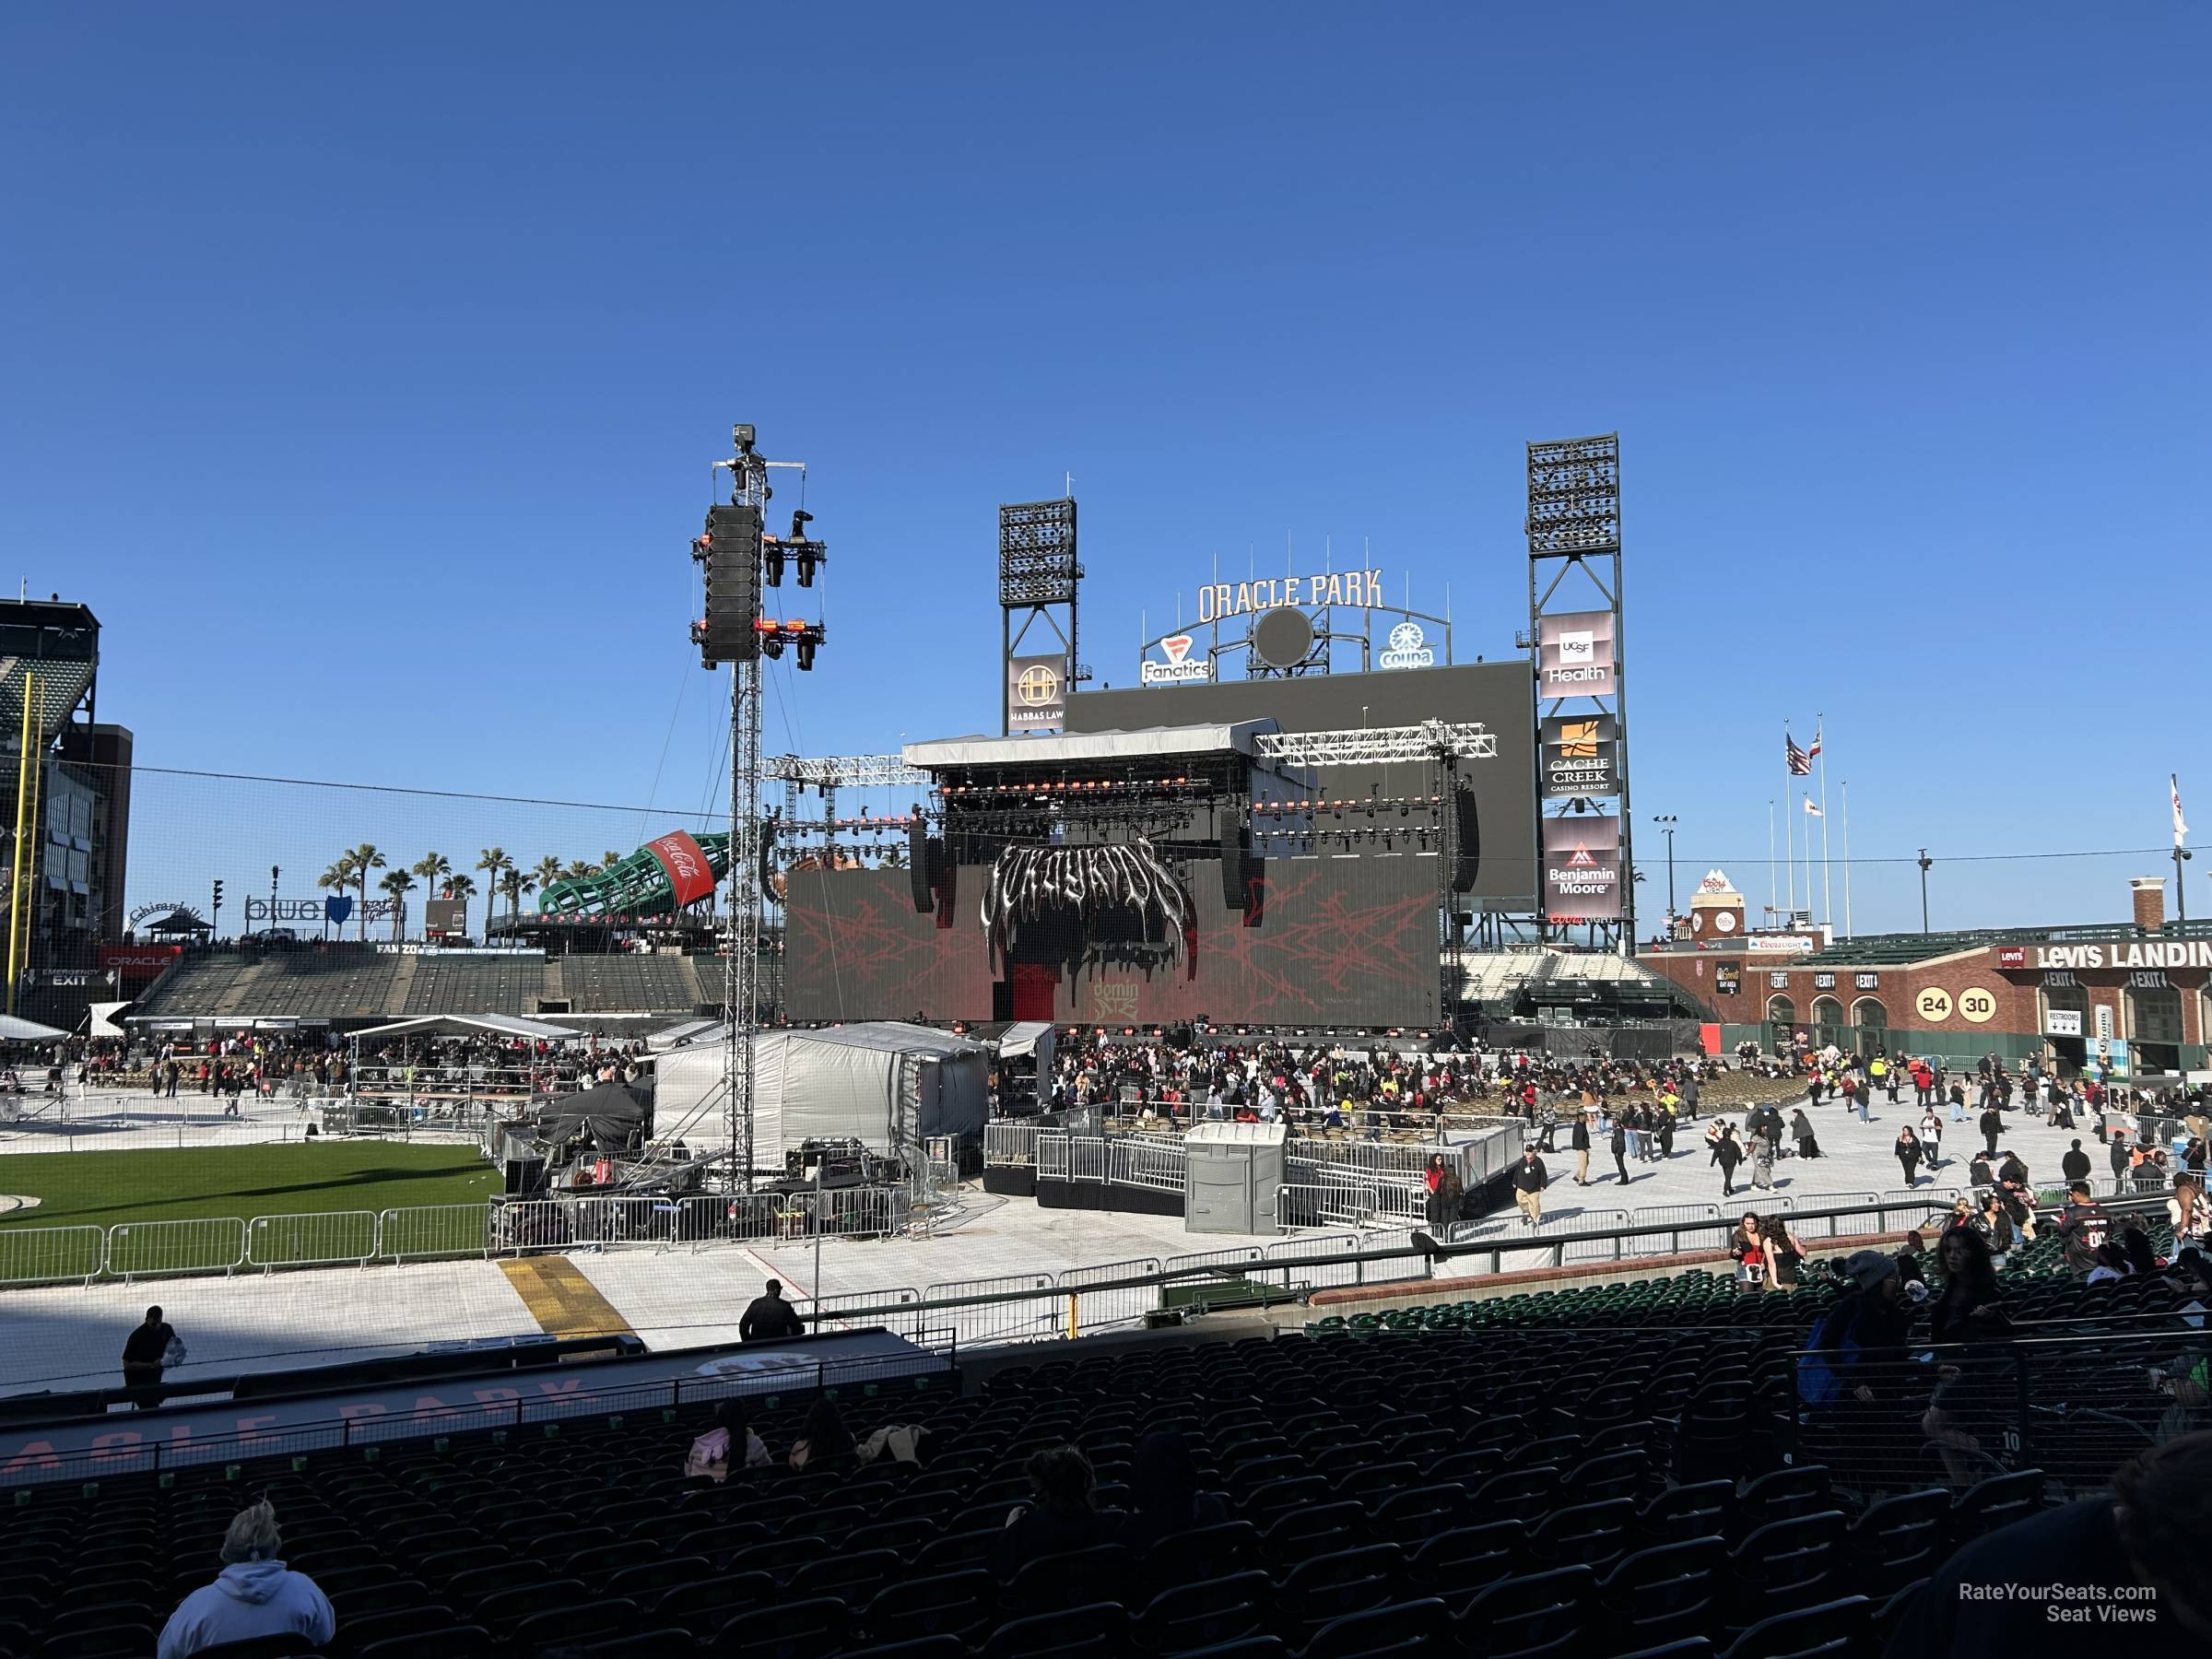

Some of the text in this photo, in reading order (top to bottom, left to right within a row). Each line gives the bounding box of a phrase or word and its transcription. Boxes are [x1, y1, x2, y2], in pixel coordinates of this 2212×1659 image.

[1199, 569, 1383, 623] ORACLE PARK
[1562, 641, 1590, 653] UCSF
[1382, 652, 1431, 668] coupa
[1144, 662, 1210, 679] Fanatics
[1549, 666, 1605, 683] Health
[1010, 710, 1065, 722] HABBAS LAW
[1550, 758, 1609, 771] CACHE
[1552, 771, 1607, 782] CREEK
[1549, 867, 1615, 883] Benjamin
[244, 895, 320, 921] blue
[376, 944, 399, 955] FAN
[2111, 941, 2212, 968] LANDIN
[107, 957, 172, 966] ORACLE
[53, 975, 89, 986] EXIT
[1773, 976, 1785, 989] EXIT
[1818, 974, 1832, 988] EXIT
[1858, 974, 1875, 989] EXIT
[2050, 971, 2070, 987] EXIT
[2137, 971, 2161, 988] EXIT
[1922, 996, 1947, 1012] 24
[1965, 997, 1990, 1013] 30
[2049, 1012, 2080, 1021] RESTROOMS
[2002, 1430, 2020, 1452] 10
